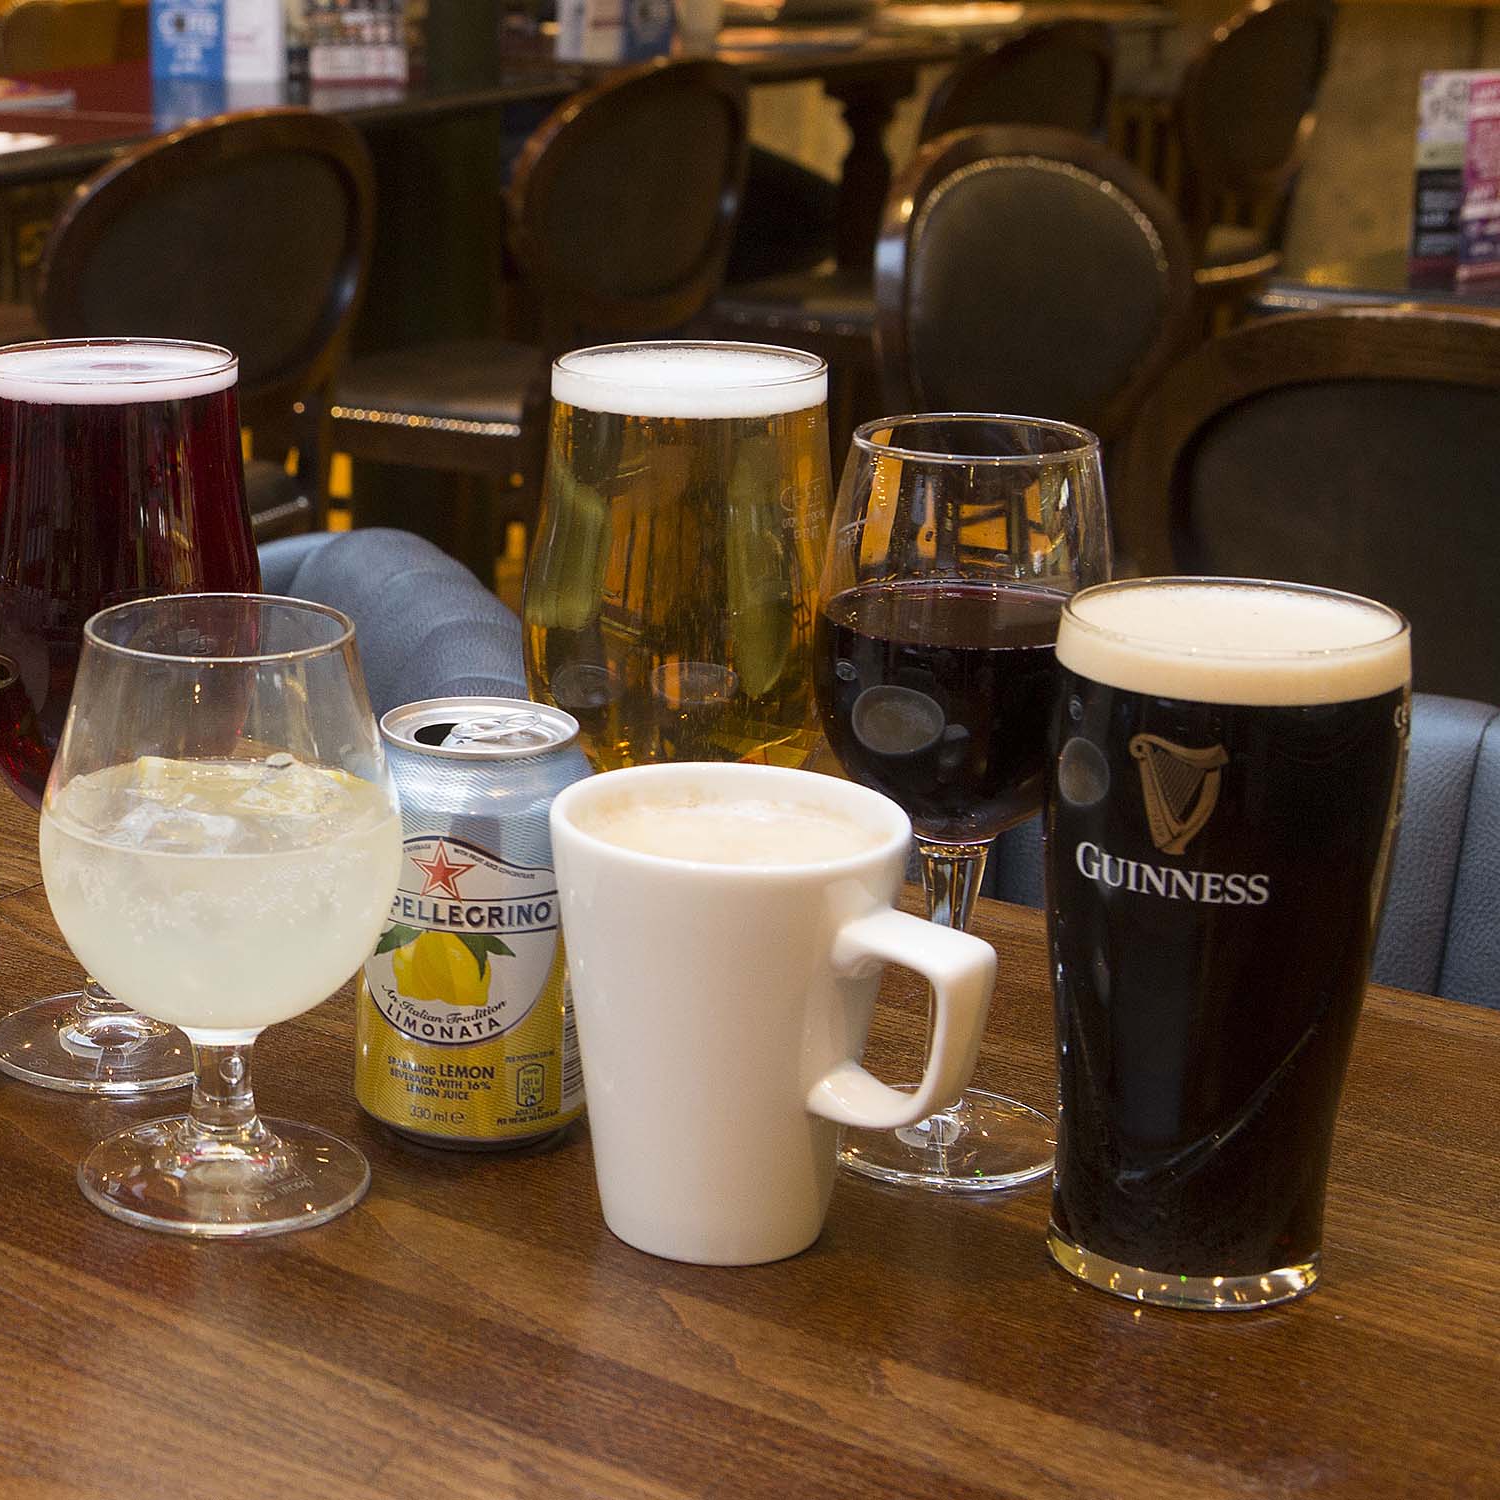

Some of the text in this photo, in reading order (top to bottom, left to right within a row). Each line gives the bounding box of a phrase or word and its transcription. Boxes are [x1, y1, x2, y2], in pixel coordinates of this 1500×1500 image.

[1075, 840, 1270, 906] GUINNESS
[381, 984, 508, 1025] An Italian Tradition
[386, 1003, 501, 1040] LIMONATA
[387, 1055, 495, 1080] SPARKLING LEMON
[389, 1067, 492, 1091] BEVERAGE WITH 16%
[406, 1083, 470, 1101] LEMON JUICE
[410, 1104, 432, 1120] 330
[434, 1112, 448, 1124] ml
